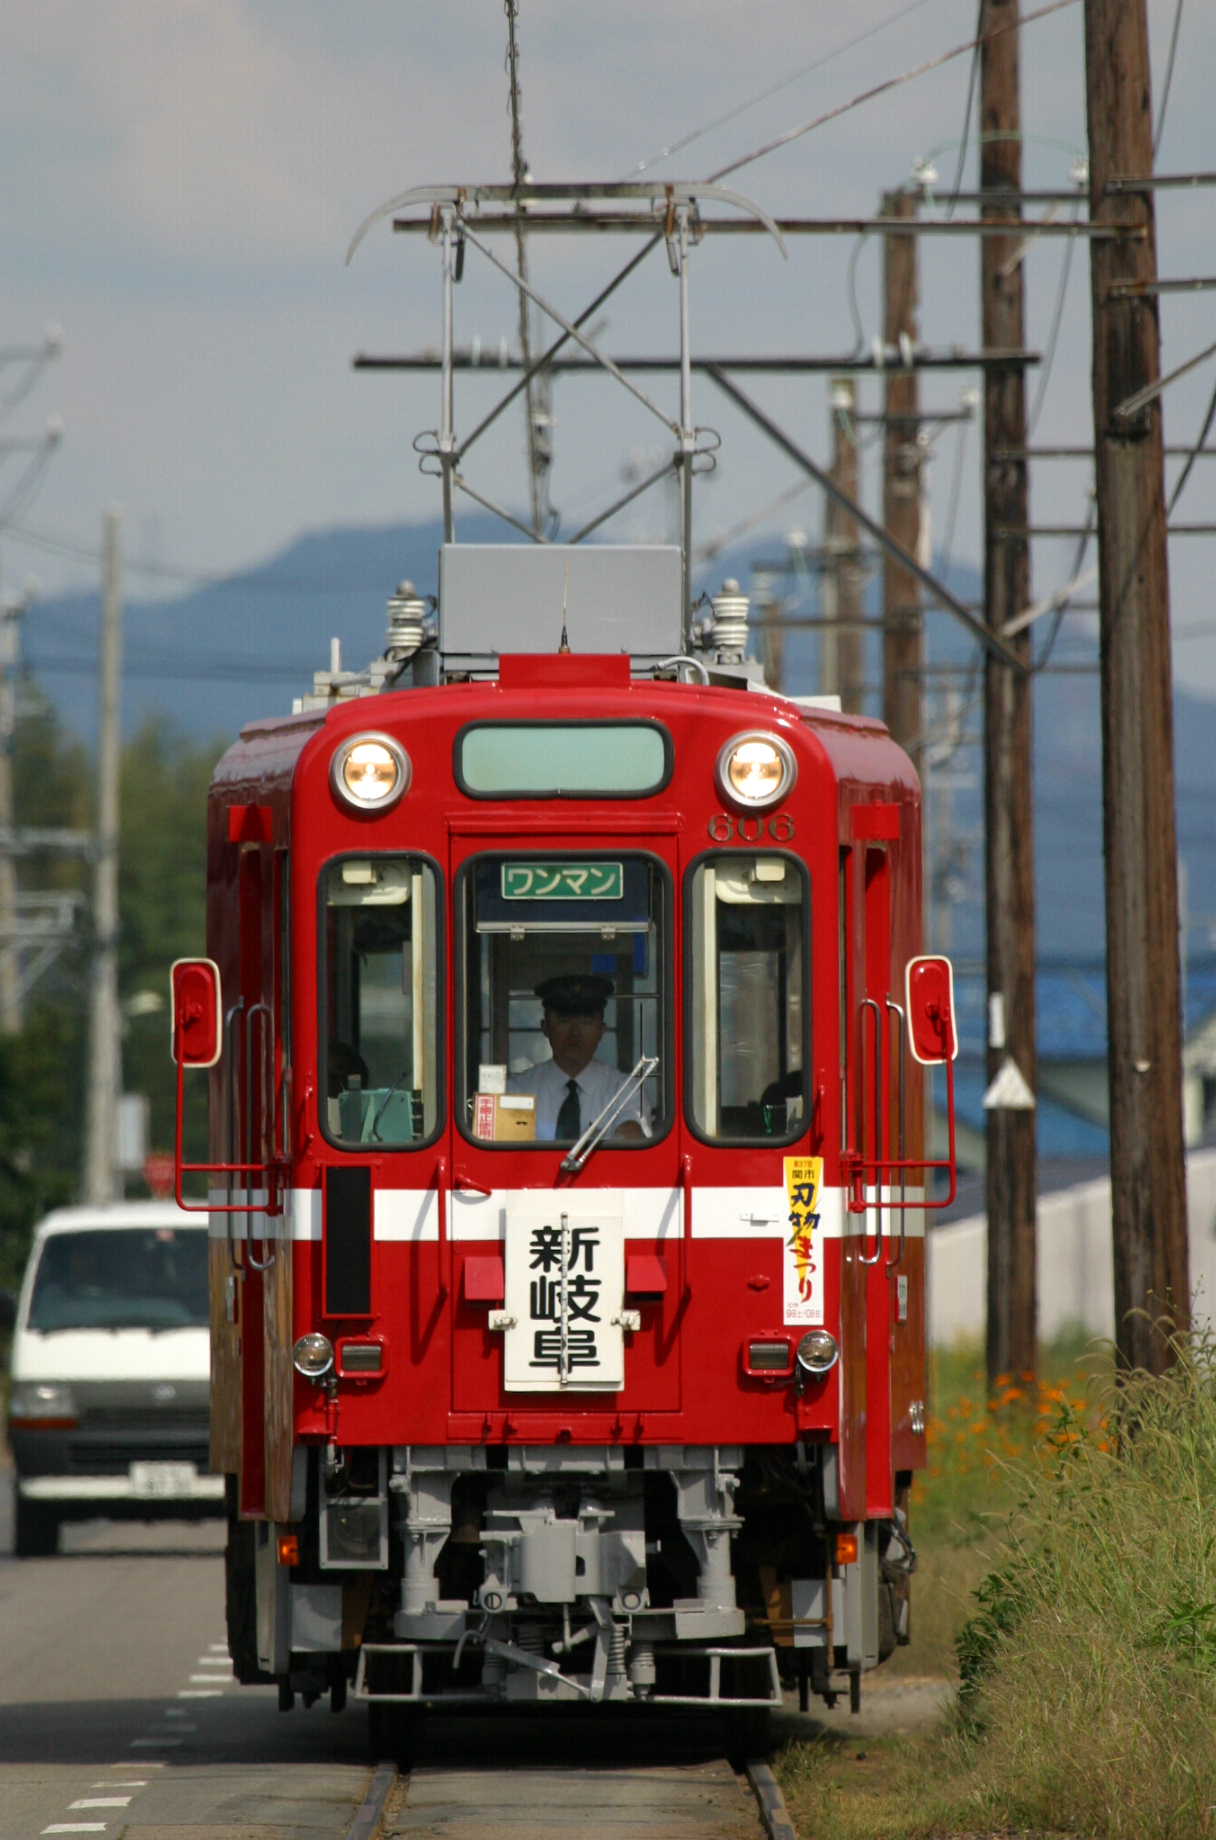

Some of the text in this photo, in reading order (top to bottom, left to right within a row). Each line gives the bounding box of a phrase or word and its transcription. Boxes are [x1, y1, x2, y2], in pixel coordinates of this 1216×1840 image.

[707, 812, 795, 842] 606
[508, 868, 616, 895] ワンマン
[529, 1225, 602, 1374] 新岐阜
